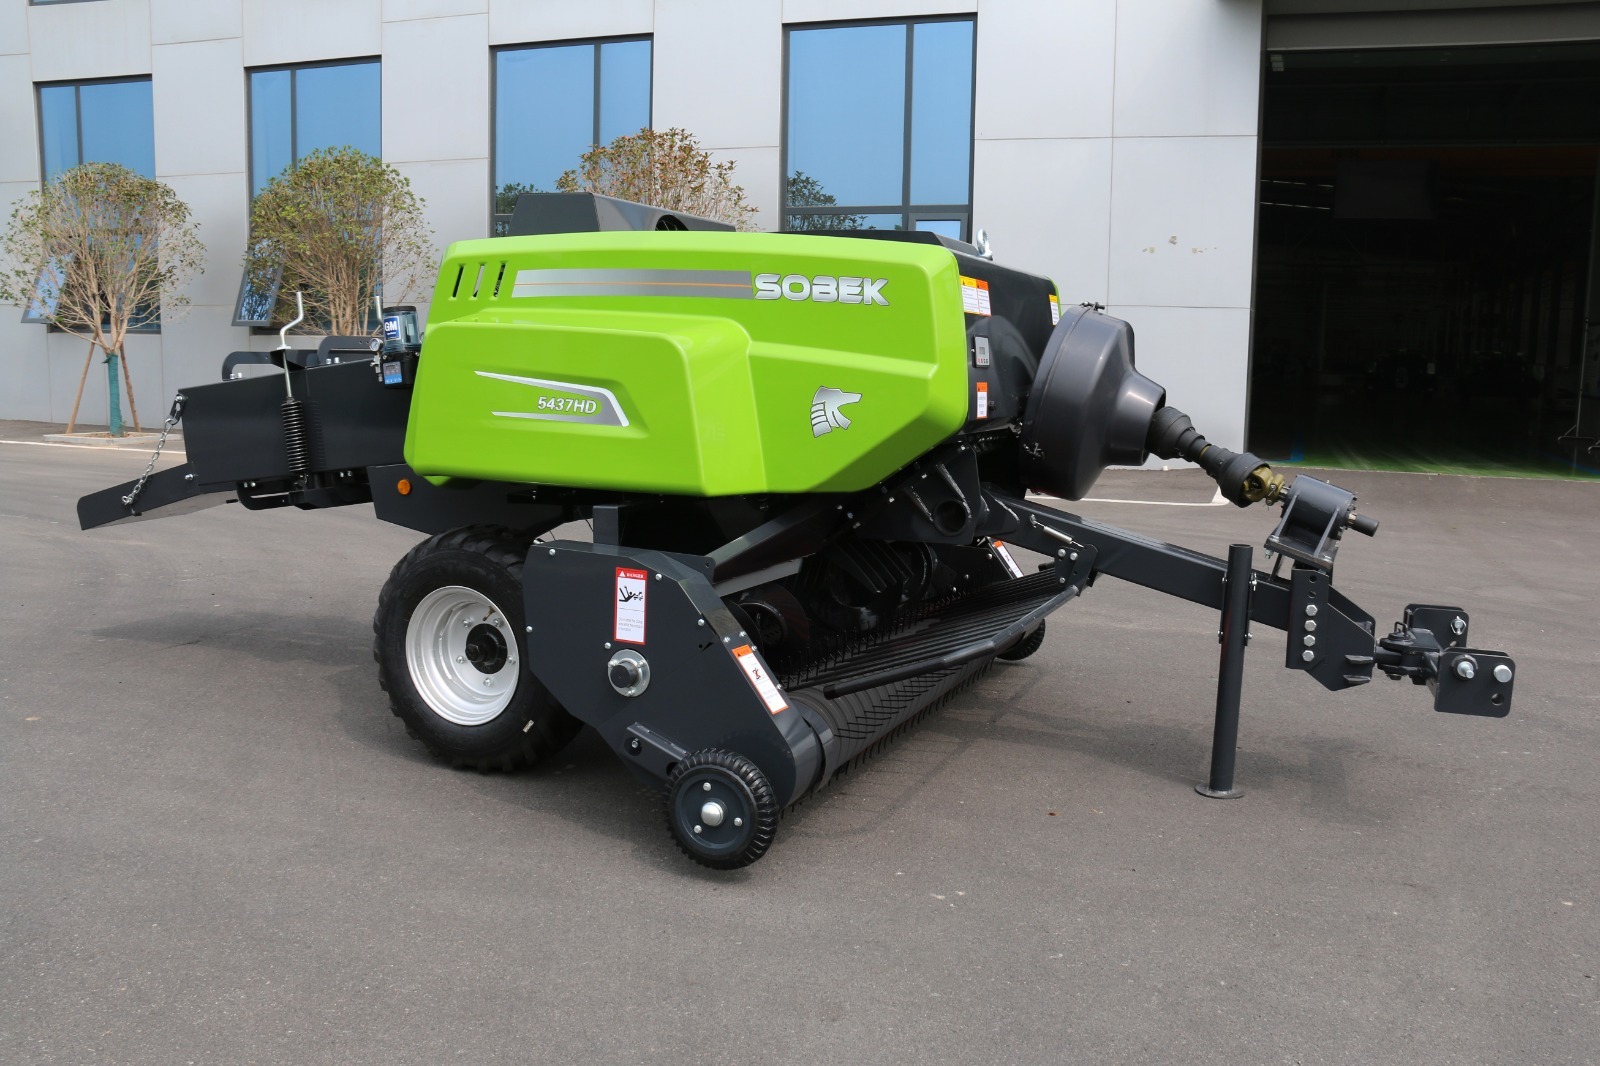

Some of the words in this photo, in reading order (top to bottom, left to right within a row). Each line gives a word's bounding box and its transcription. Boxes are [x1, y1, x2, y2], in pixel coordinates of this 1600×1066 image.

[754, 273, 889, 306] SOBEK
[384, 320, 398, 332] GM
[537, 396, 597, 414] 5437HD
